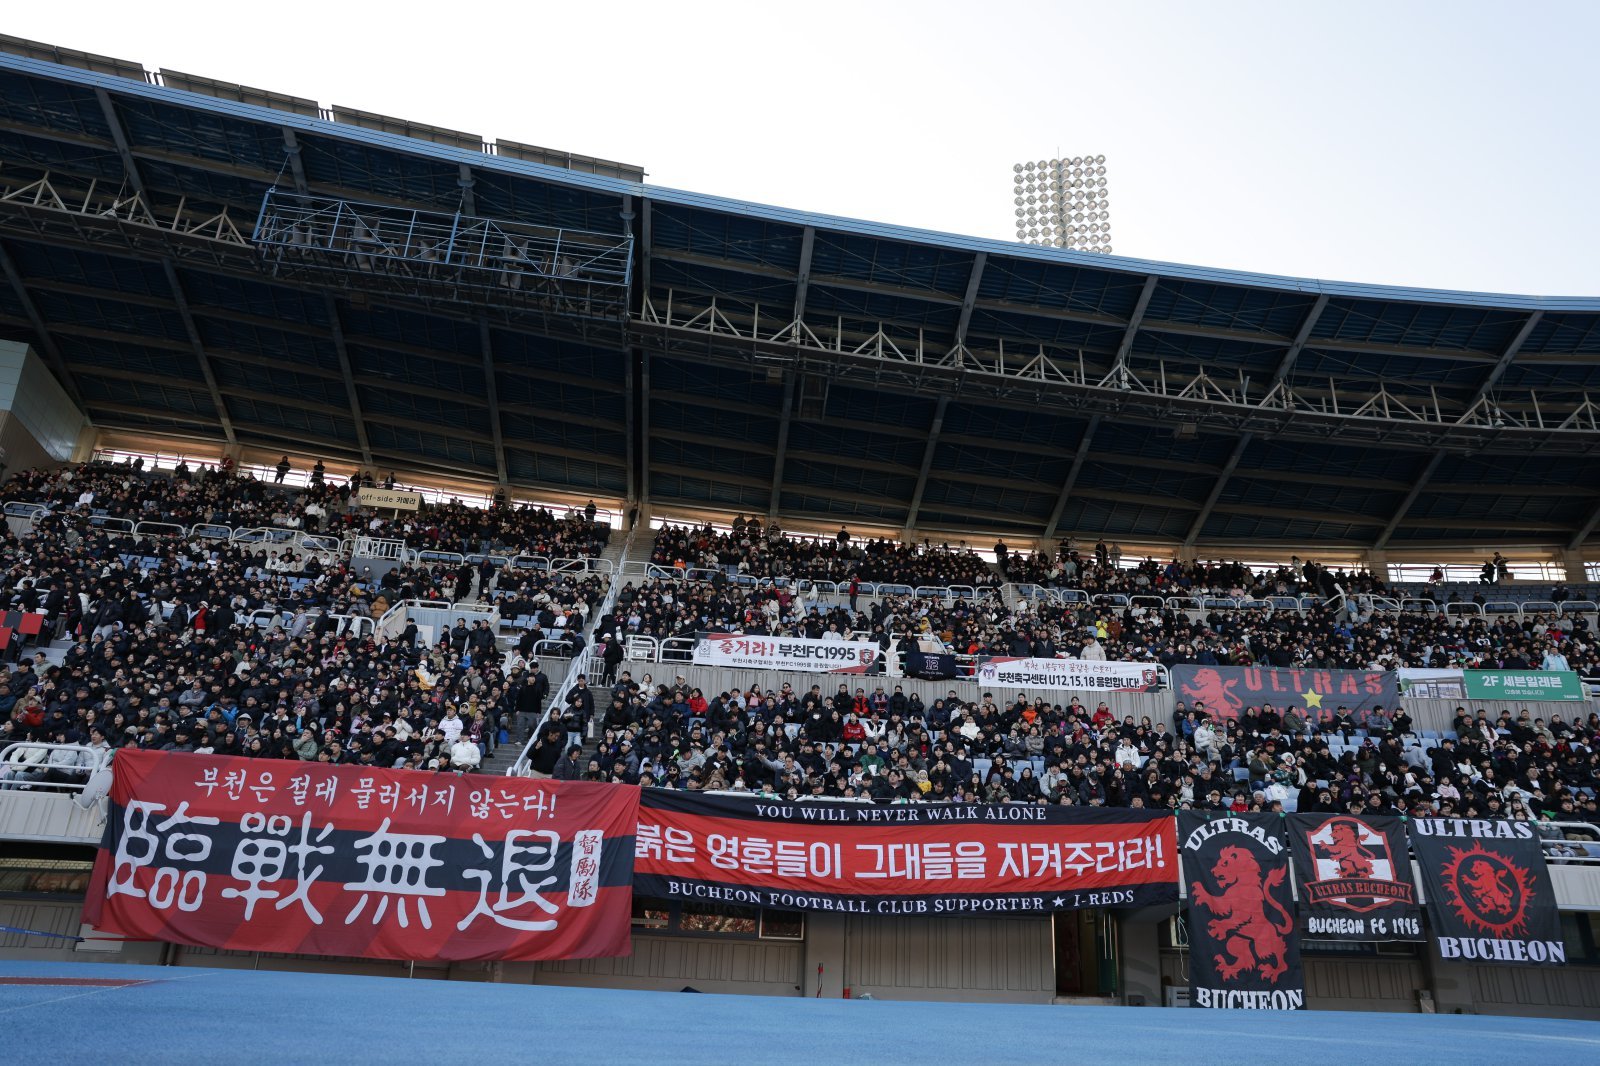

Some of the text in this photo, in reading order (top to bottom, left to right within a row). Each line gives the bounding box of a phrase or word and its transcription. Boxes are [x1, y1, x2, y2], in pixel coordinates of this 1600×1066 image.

[361, 493, 416, 505] off-side 카메라
[718, 640, 856, 660] 즐겨라! 부천FC1995
[925, 659, 939, 670] 12
[998, 672, 1140, 689] 부천축구센터 U12,15,18 응원합니다!
[1244, 667, 1383, 696] ULTRAS
[1482, 675, 1562, 688] 2F 세븐일레븐
[195, 767, 557, 821] 부천은 절대 물러서지 않는다!
[755, 804, 1047, 821] YOU WILL NEVER WALK ALONE
[1184, 817, 1284, 855] ULTRAS
[1413, 817, 1533, 839] ULTRAS
[634, 822, 1165, 880] 붉은 영혼들이 그대들을 지켜주리라!
[107, 798, 561, 931] 臨戰無退
[668, 881, 1135, 914] BUCHEON FOOTBALL CLUB SUPPORTER I-REDS
[1315, 882, 1406, 898] ULTRAS BUCHEON
[1308, 916, 1420, 935] BUCHEON FC 1995
[1438, 936, 1566, 963] BUCHEON
[1196, 986, 1303, 1011] BUCHEON
